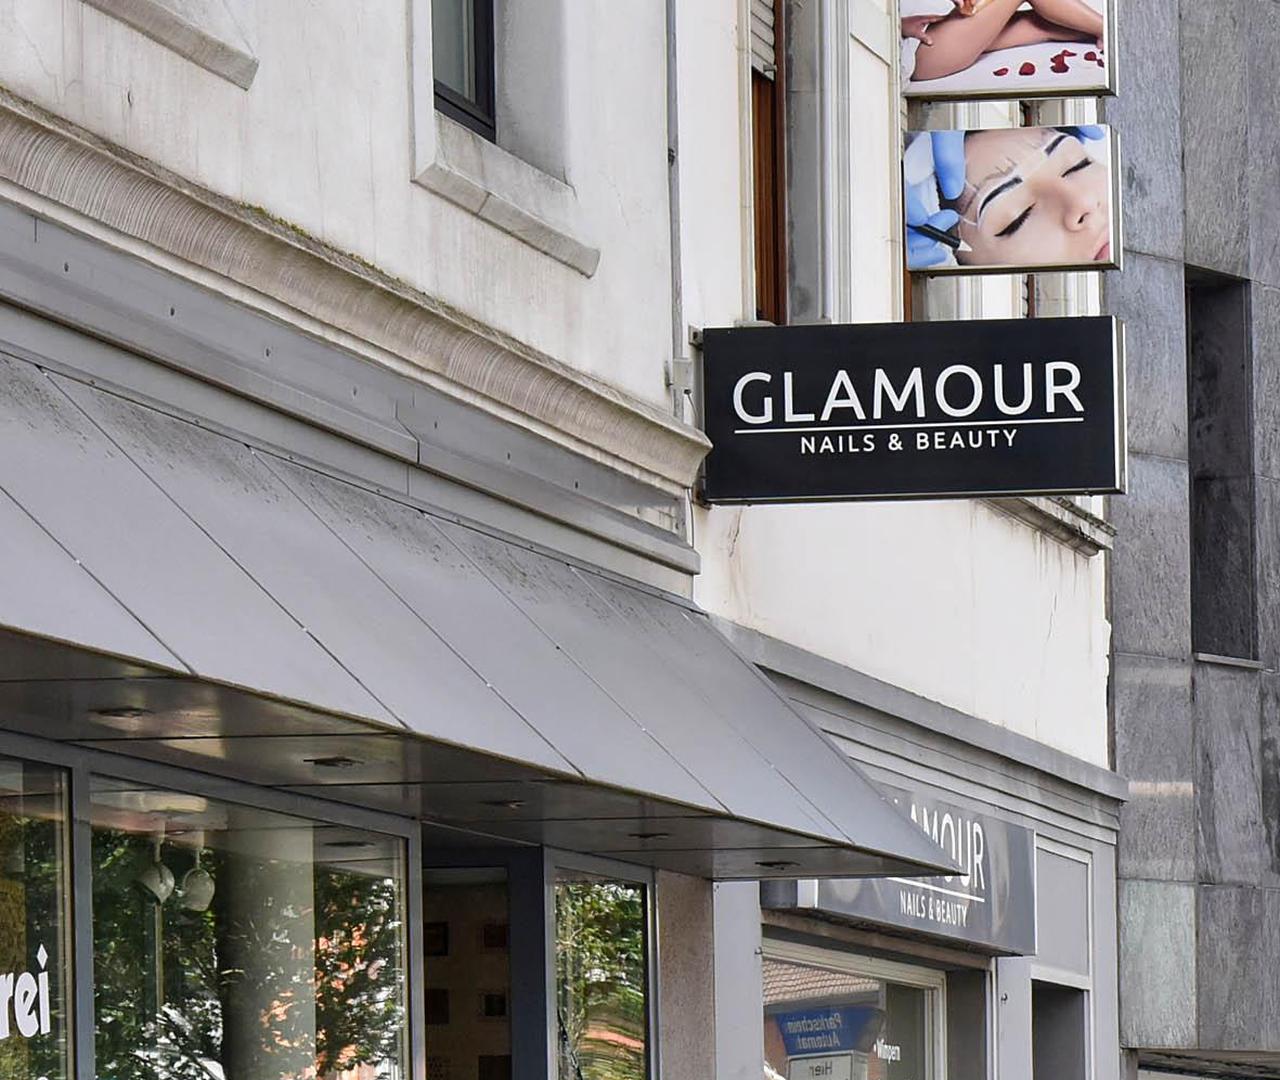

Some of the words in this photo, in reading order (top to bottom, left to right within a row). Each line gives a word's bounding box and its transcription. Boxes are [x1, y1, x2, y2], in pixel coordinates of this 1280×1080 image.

[733, 361, 1084, 424] GLAMOUR
[801, 434, 875, 454] NAILS
[888, 433, 903, 451] &
[916, 429, 1018, 450] BEAUTY
[900, 889, 926, 918] NAILS
[928, 896, 934, 920] &
[936, 899, 968, 928] BEAUTY
